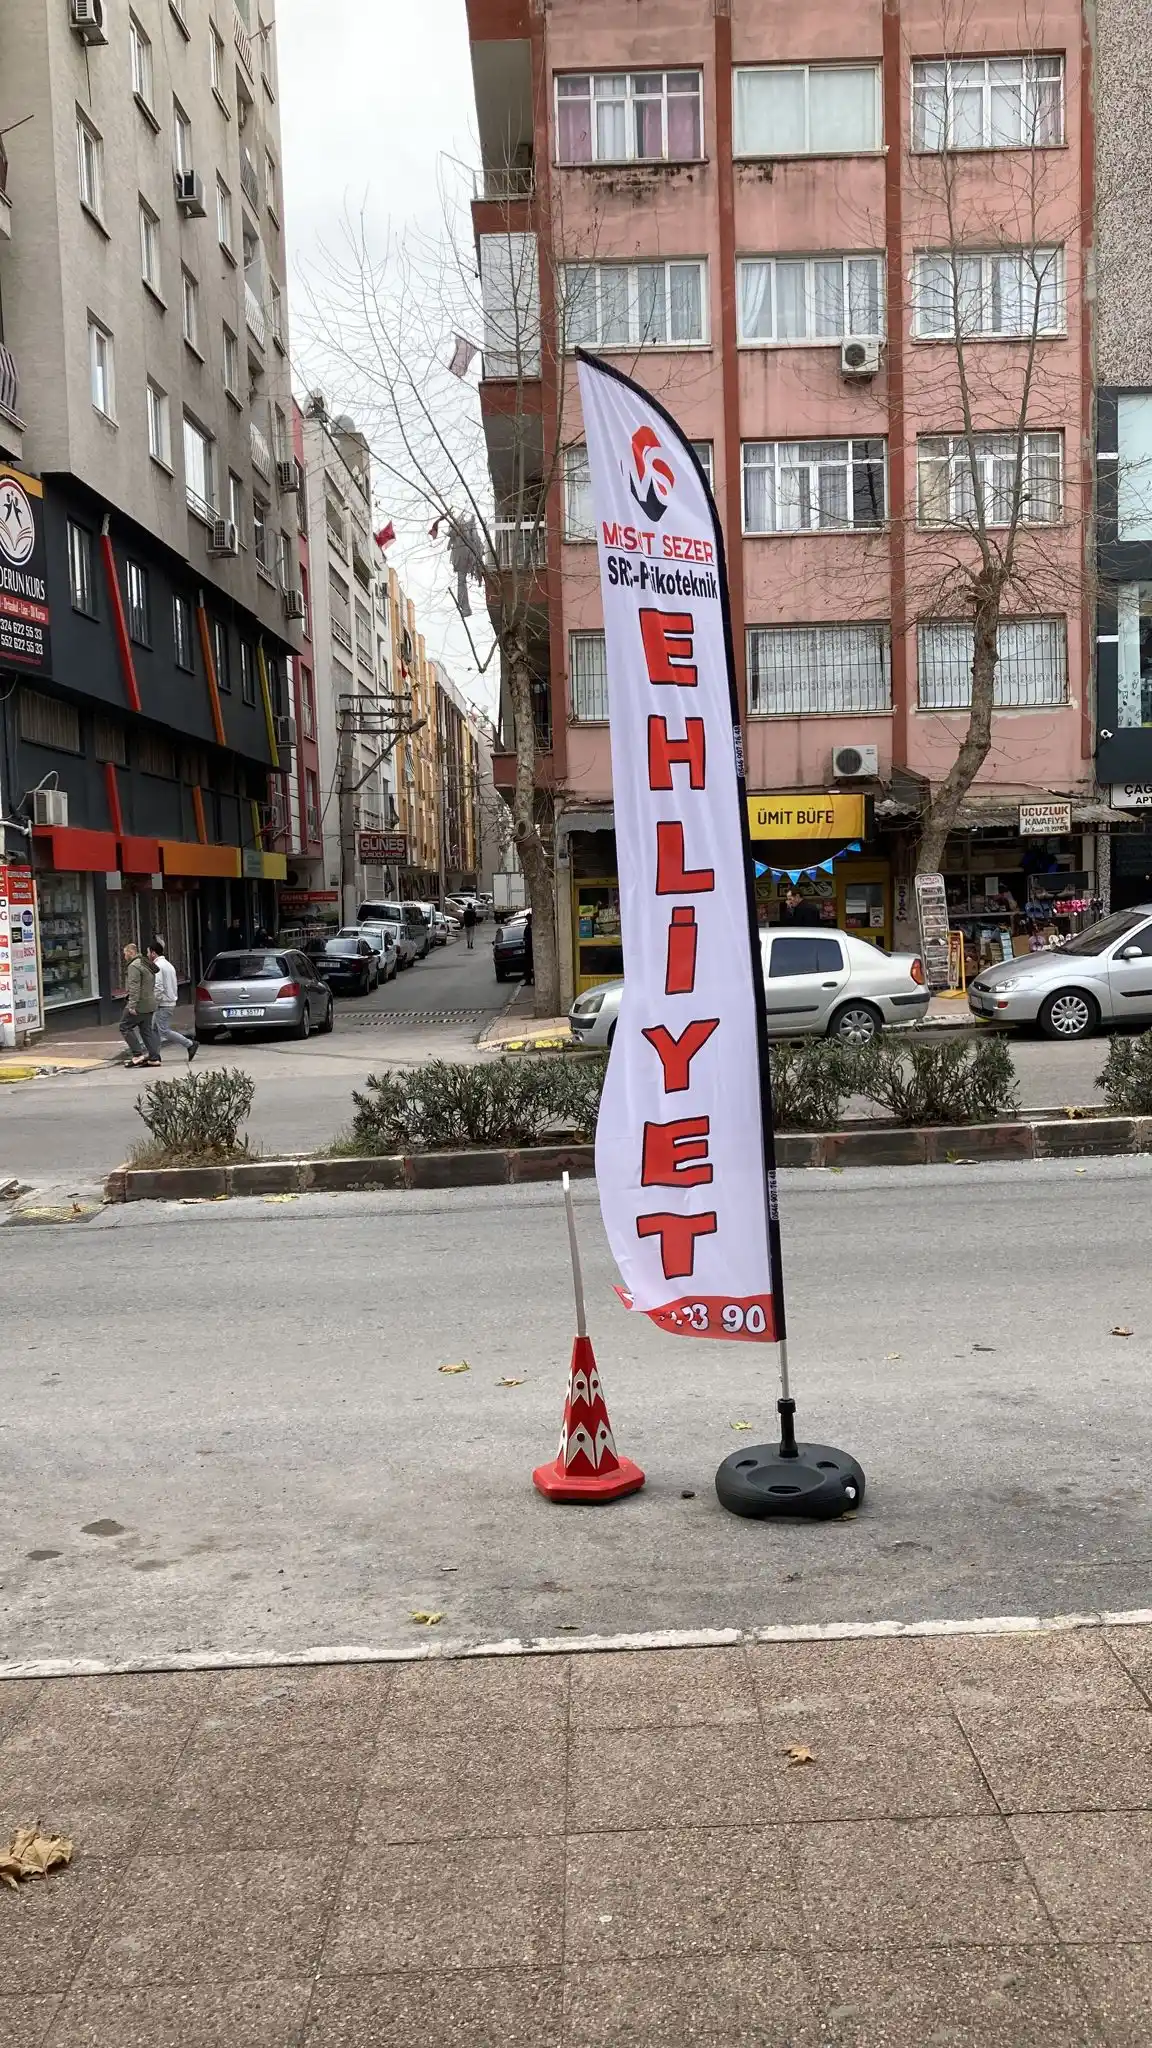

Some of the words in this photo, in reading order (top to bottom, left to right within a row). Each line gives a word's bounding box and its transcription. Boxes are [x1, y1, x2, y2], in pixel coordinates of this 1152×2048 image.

[662, 534, 714, 562] SEZER
[25, 574, 45, 600] KURS
[13, 621, 25, 636] 622
[25, 625, 34, 638] 55
[14, 637, 26, 651] 622
[26, 640, 35, 653] 55
[757, 808, 793, 825] ÜMİT
[797, 808, 834, 824] BÜFE
[1021, 806, 1069, 817] UCUZLUK
[721, 1303, 767, 1333] 90
